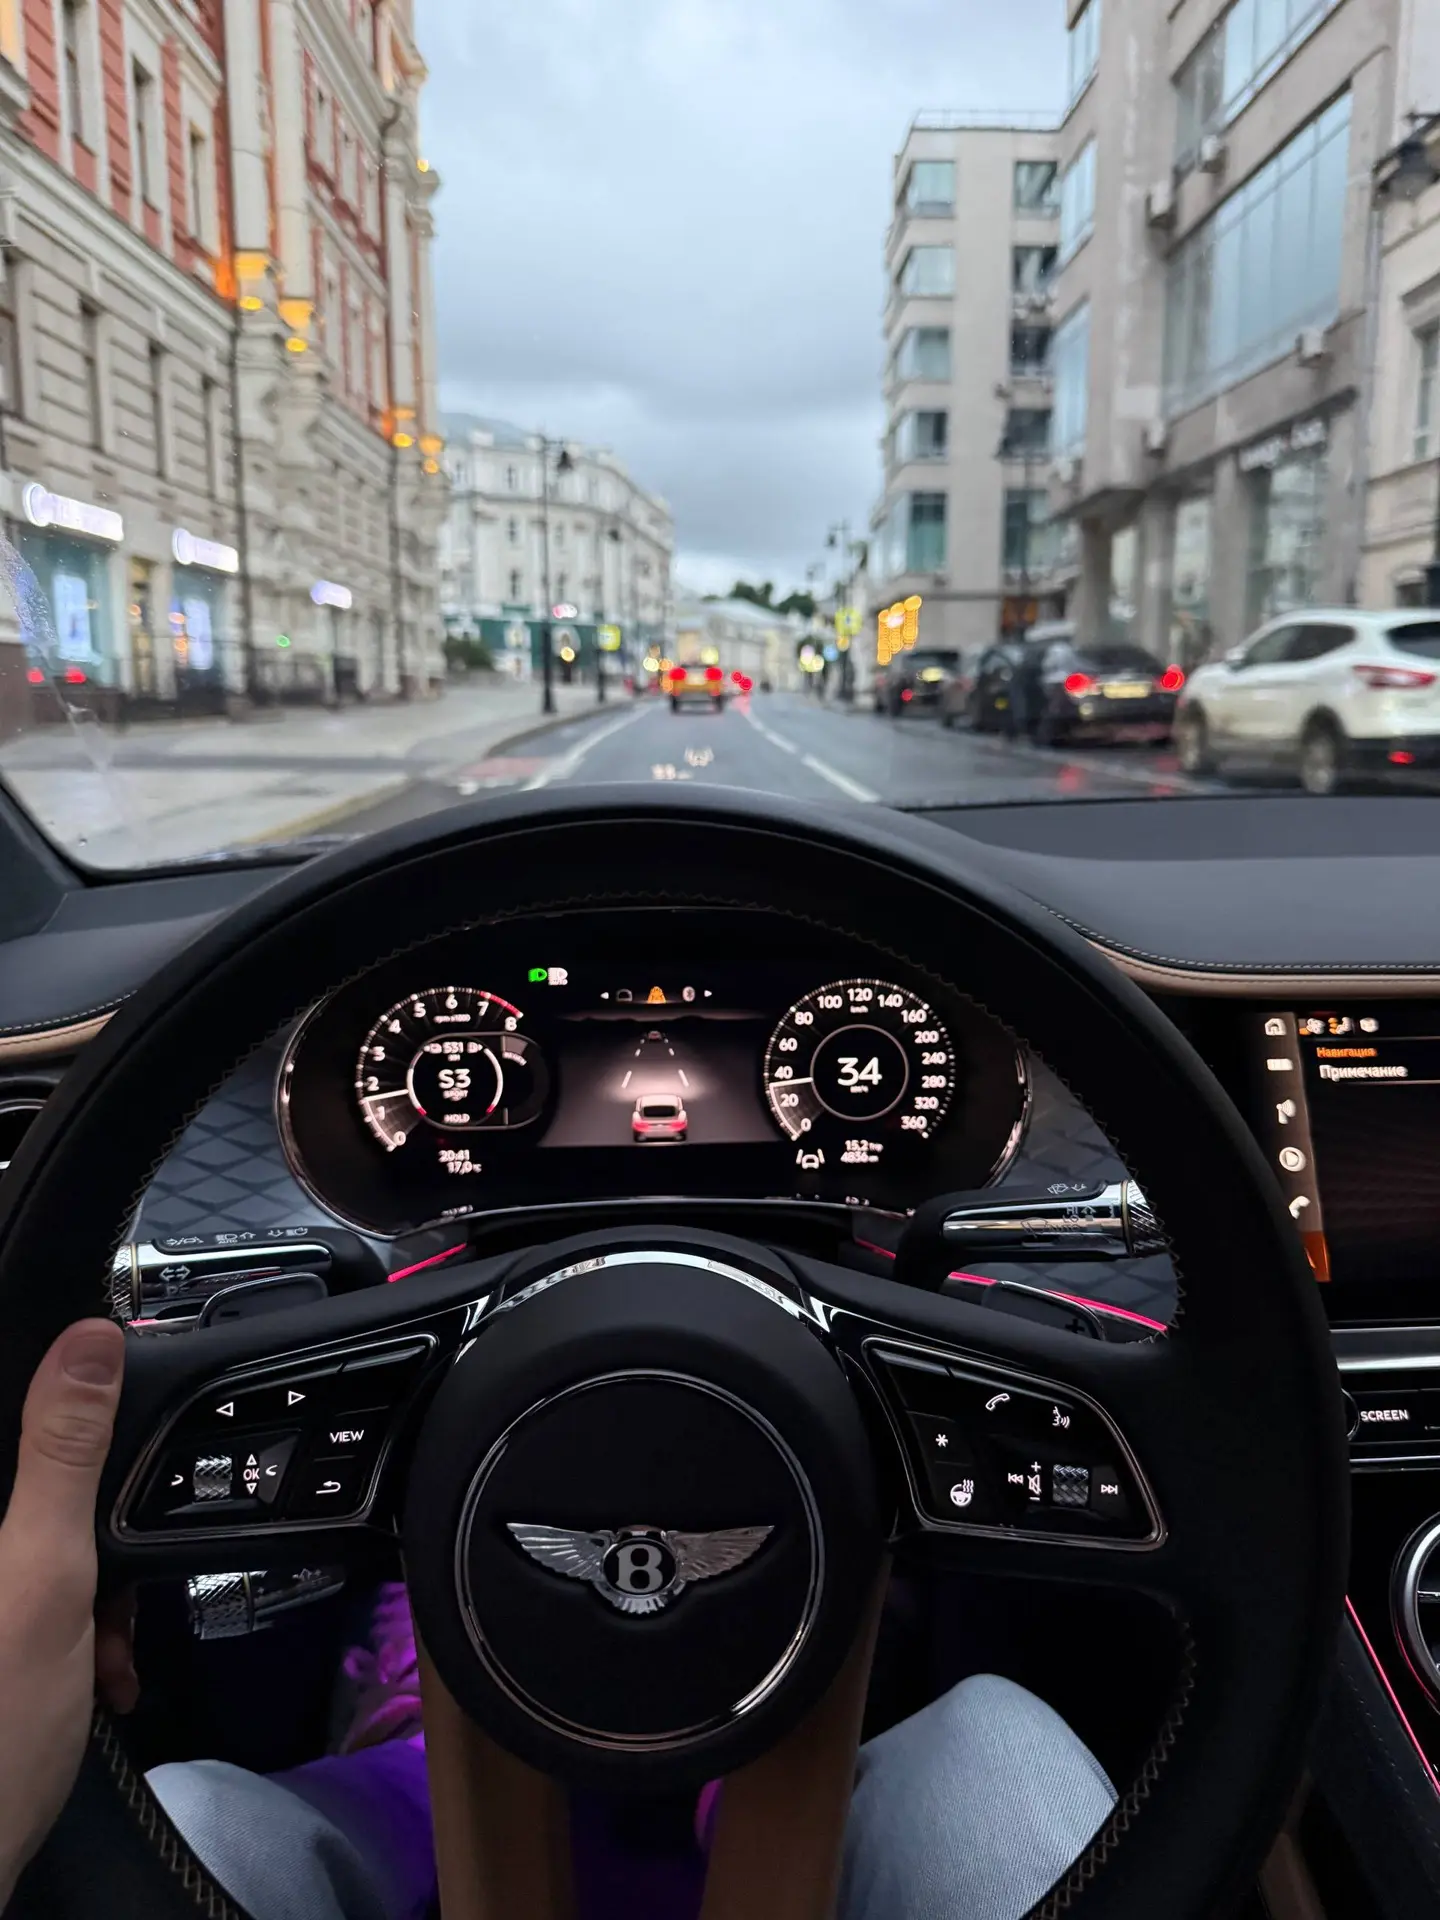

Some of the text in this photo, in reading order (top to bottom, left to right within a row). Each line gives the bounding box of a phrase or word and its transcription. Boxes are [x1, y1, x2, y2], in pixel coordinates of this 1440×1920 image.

[445, 993, 458, 1009] 6
[817, 995, 843, 1009] 100
[848, 987, 873, 1002] 120
[877, 993, 903, 1008] 140
[413, 1002, 426, 1018] 5
[477, 1001, 489, 1016] 7
[505, 1016, 517, 1031] 8
[795, 1011, 814, 1026] 80
[901, 1009, 927, 1024] 160
[388, 1019, 402, 1034] 4
[779, 1038, 798, 1052] 60
[914, 1031, 939, 1044] 200
[372, 1046, 385, 1061] 3
[922, 1052, 947, 1065] 240
[1316, 1047, 1377, 1058] Навигация
[438, 1068, 471, 1089] S3
[774, 1065, 793, 1080] 40
[837, 1057, 883, 1087] 34
[1319, 1064, 1408, 1082] Примечание
[366, 1076, 379, 1091] 2
[922, 1075, 947, 1089] 280
[780, 1093, 799, 1107] 20
[914, 1096, 939, 1110] 320
[375, 1105, 386, 1120] 1
[801, 1118, 812, 1132] 0
[901, 1115, 927, 1130] 360
[392, 1131, 406, 1146] 0
[1360, 1409, 1409, 1422] SCREEN
[330, 1430, 364, 1443] VIEW
[243, 1468, 260, 1481] OK
[615, 1543, 663, 1594] B
